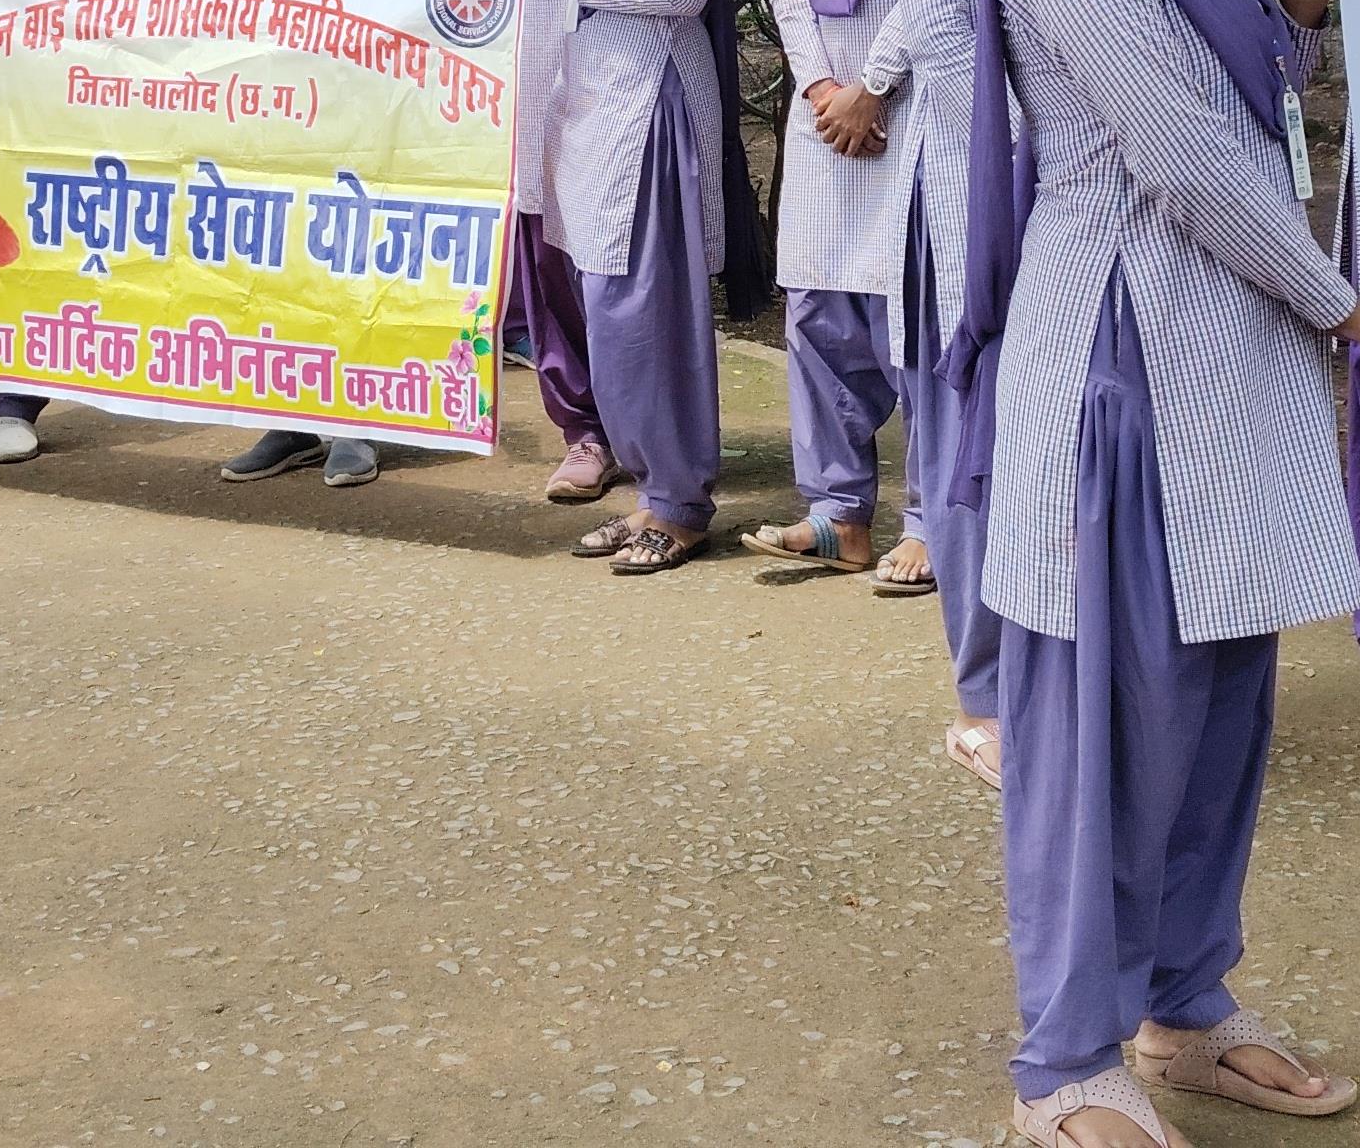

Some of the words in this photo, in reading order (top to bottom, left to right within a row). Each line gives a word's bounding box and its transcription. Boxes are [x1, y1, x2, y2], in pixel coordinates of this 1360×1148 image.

[458, 23, 488, 36] SERVICE
[225, 72, 319, 129] (छ.ग.)
[25, 155, 176, 274] राष्ट्रीय
[186, 160, 295, 268] सेवा
[308, 170, 501, 287] योजना
[23, 303, 138, 378] हार्दिक
[148, 317, 337, 403] अभिनंदन
[343, 361, 432, 415] करती
